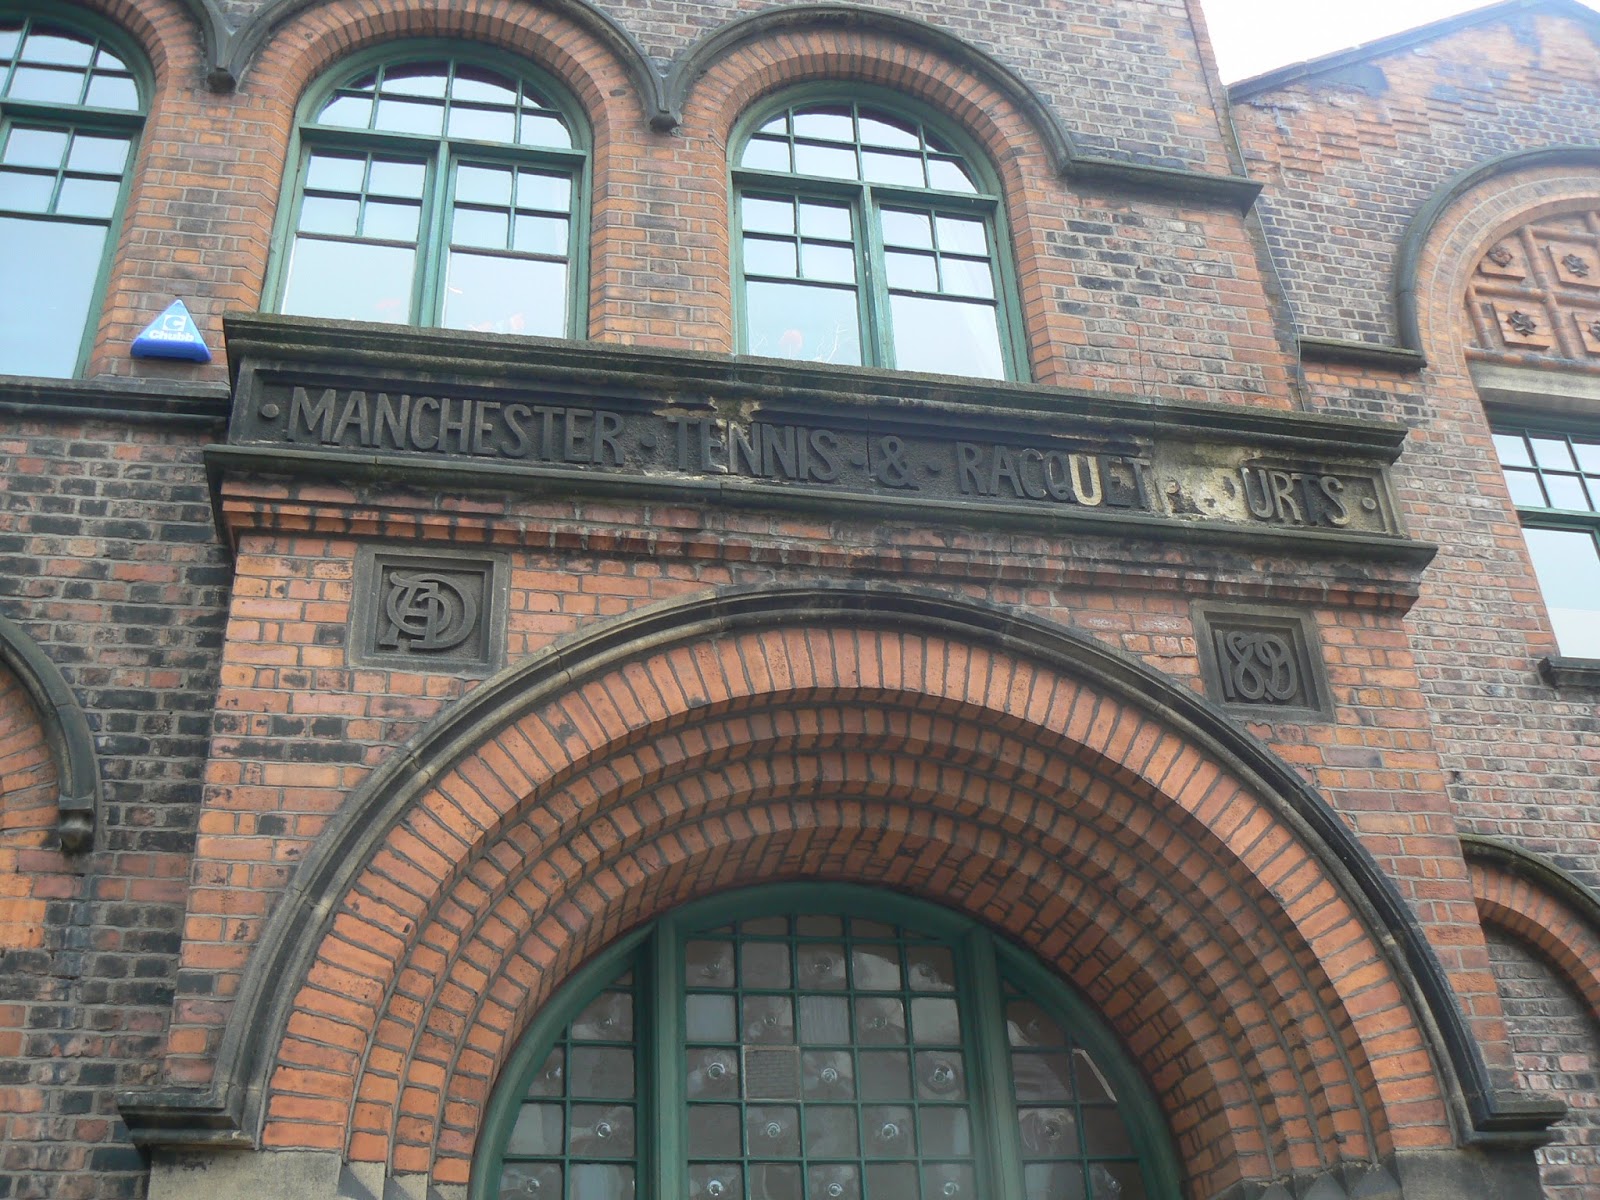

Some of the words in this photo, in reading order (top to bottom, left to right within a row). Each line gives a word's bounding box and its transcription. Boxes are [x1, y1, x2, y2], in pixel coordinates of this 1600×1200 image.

[148, 329, 195, 342] Chubb
[287, 386, 626, 467] MANCHESTER
[667, 416, 840, 482] TENNIS
[878, 435, 919, 488] &
[956, 441, 1151, 507] RACQUET
[1193, 464, 1351, 527] URTS
